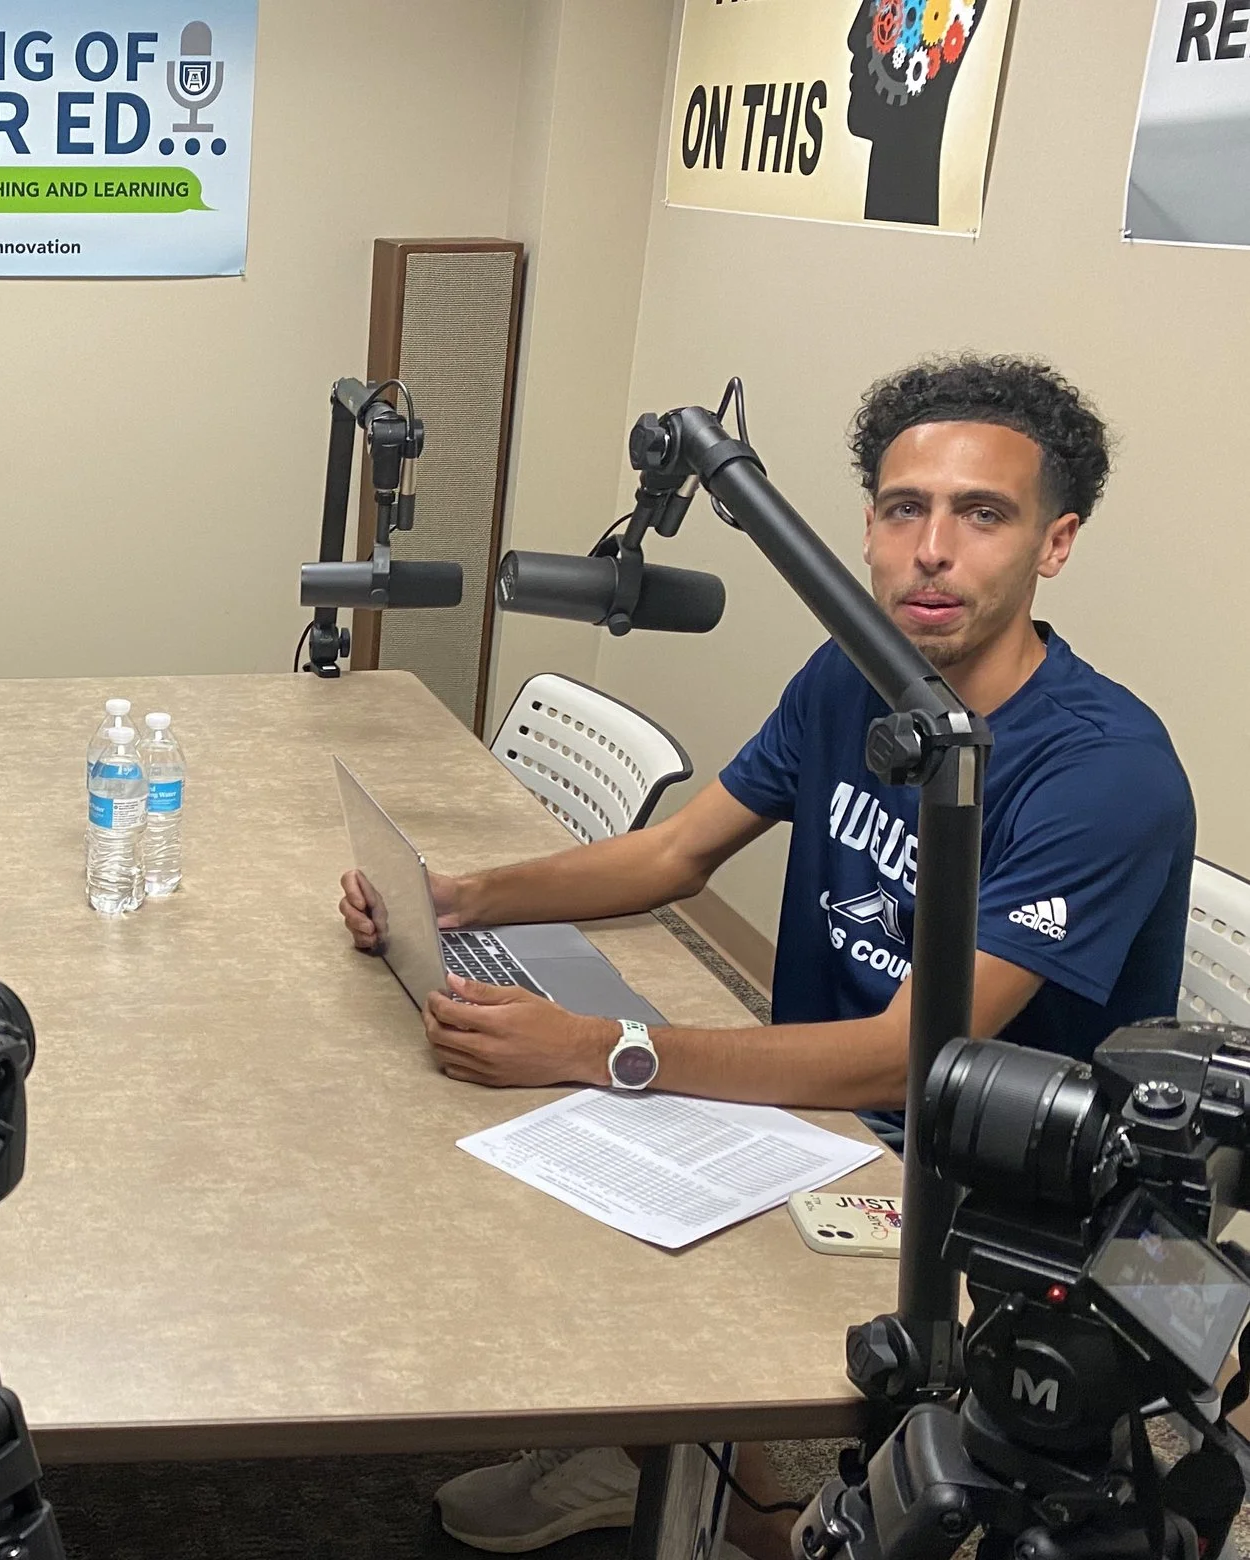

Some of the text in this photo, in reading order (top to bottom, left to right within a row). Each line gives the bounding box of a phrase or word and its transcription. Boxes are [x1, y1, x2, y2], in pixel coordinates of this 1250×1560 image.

[75, 31, 158, 82] OF
[57, 91, 227, 156] ED...
[682, 79, 827, 176] ON THIS
[45, 181, 88, 198] AND
[94, 182, 190, 198] LEARNING
[1008, 910, 1067, 941] adidas
[835, 1196, 896, 1211] JUST
[1012, 1368, 1059, 1412] M
